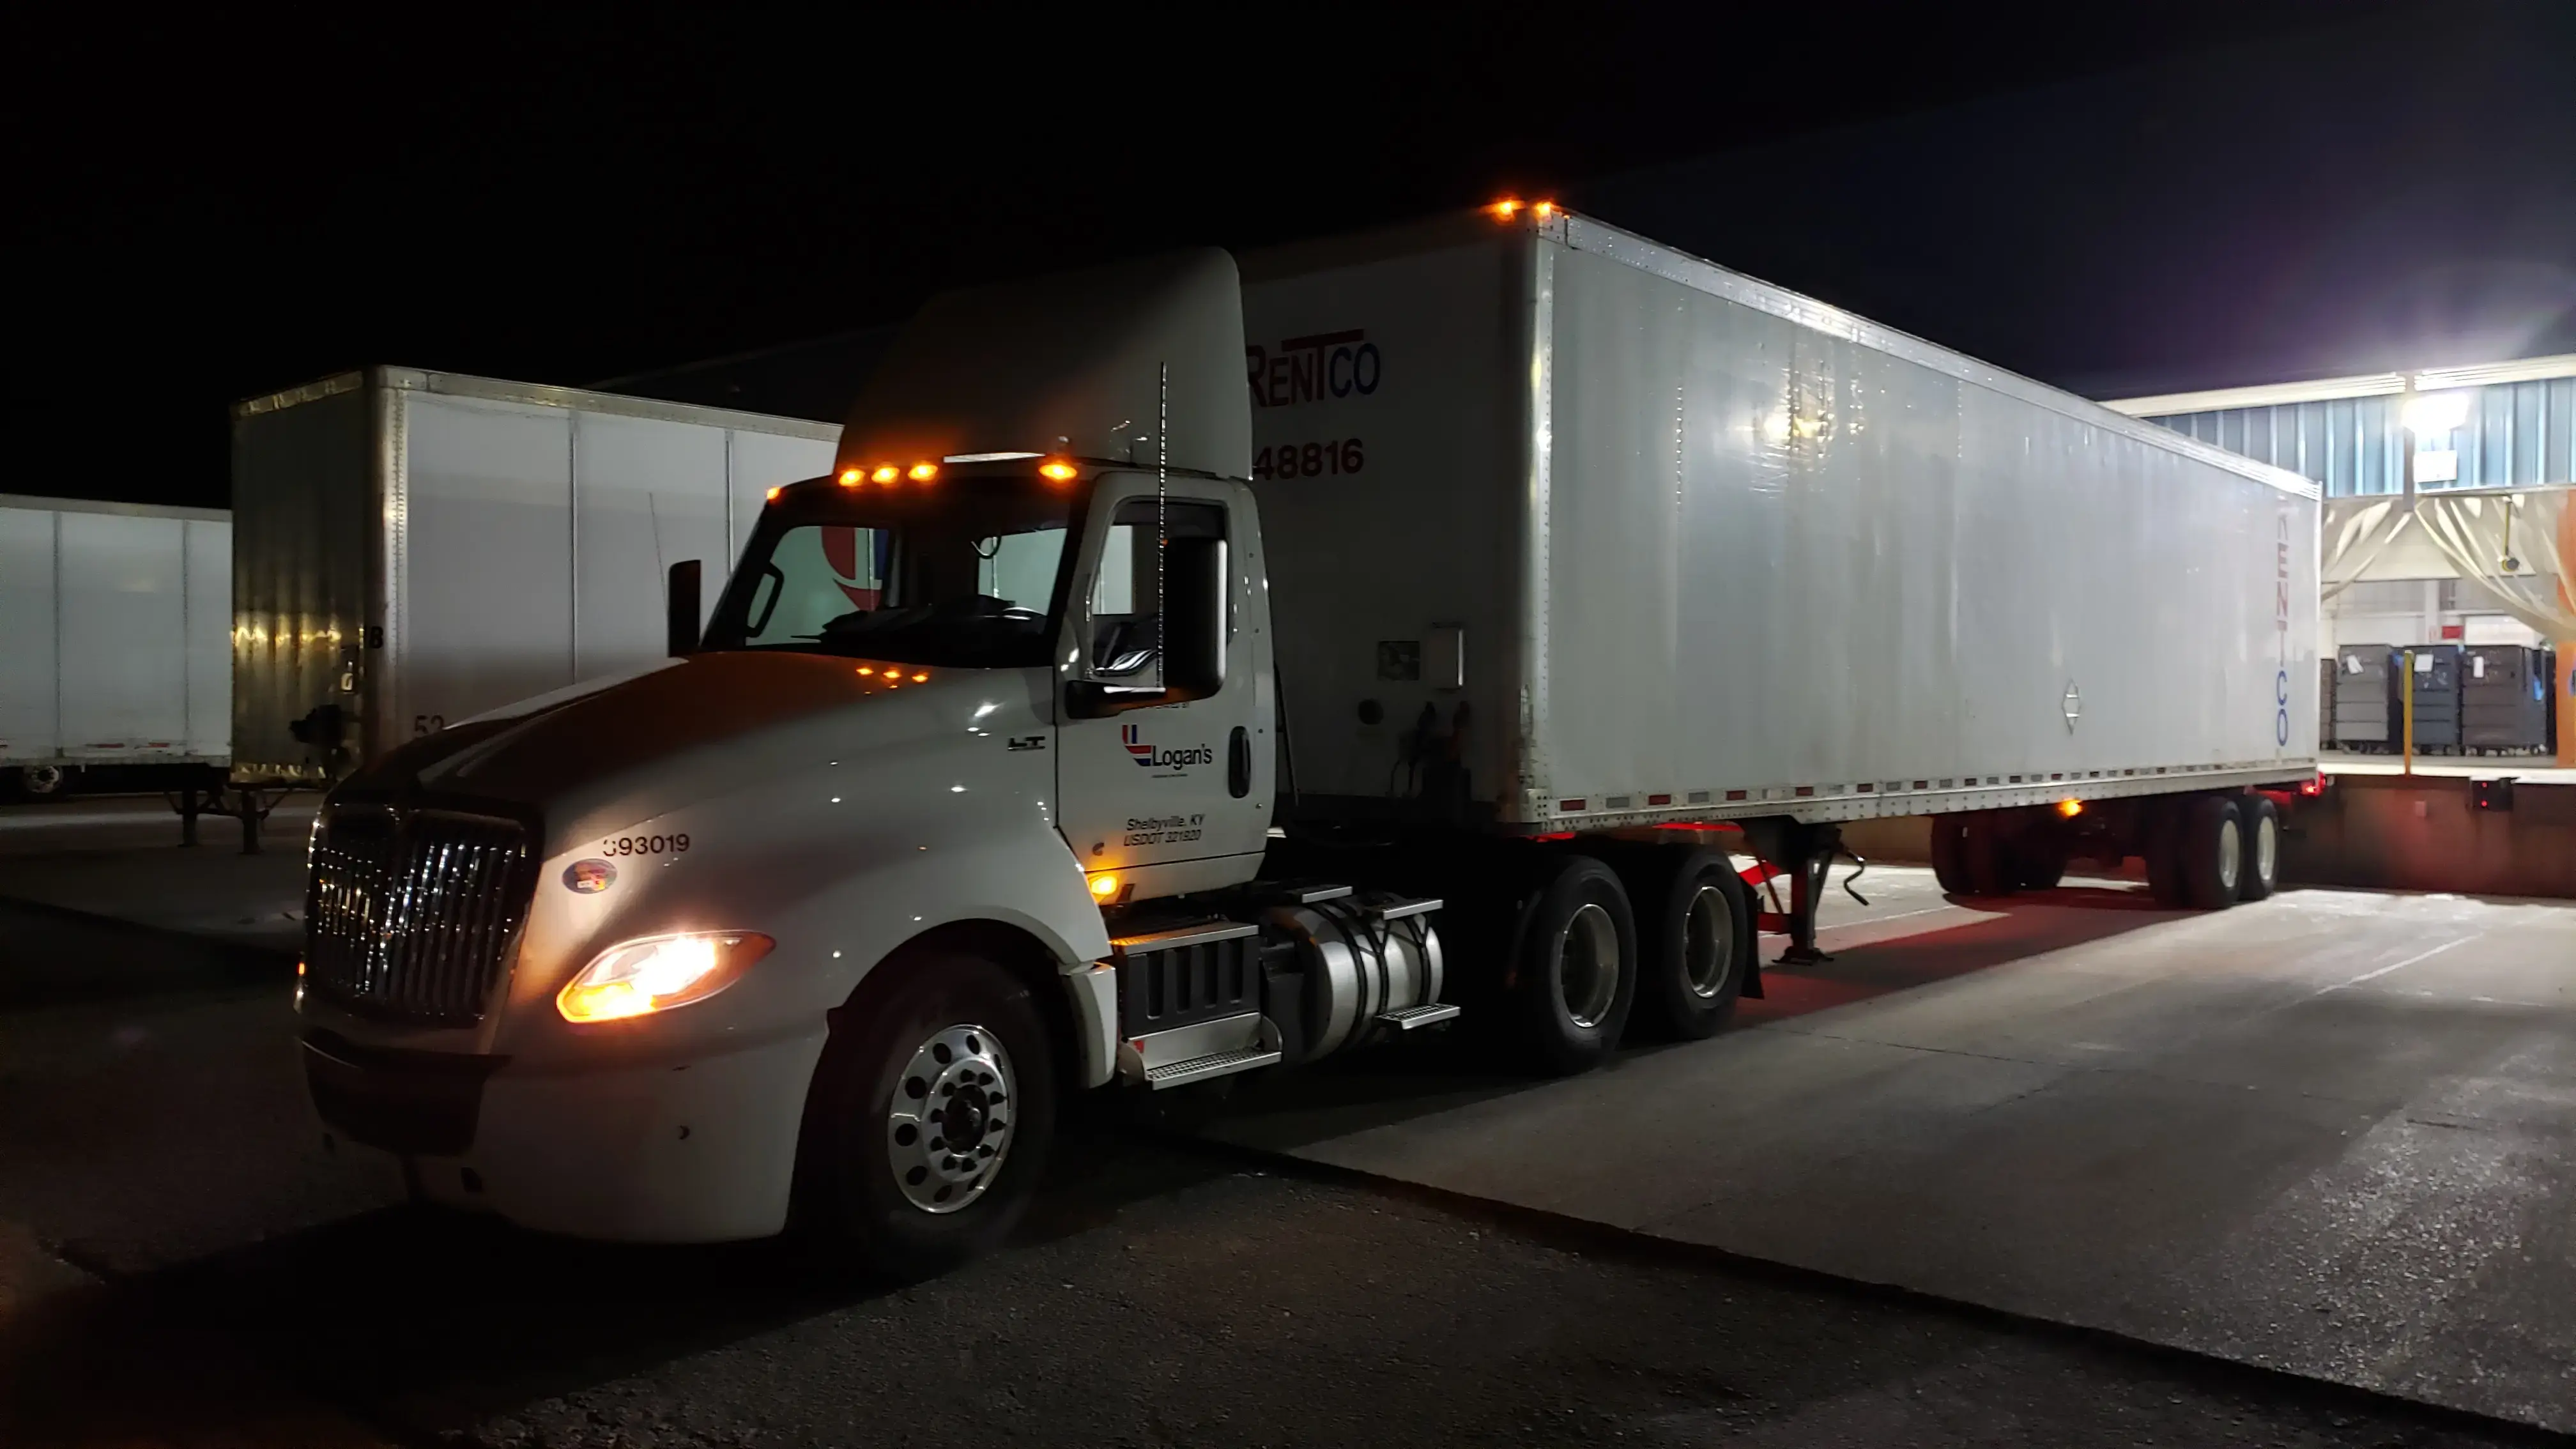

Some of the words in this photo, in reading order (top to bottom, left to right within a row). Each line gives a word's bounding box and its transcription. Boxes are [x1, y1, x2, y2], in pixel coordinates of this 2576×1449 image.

[1252, 438, 1364, 480] 48816
[1153, 743, 1212, 770] Logan's
[1190, 813, 1206, 826] KY
[1124, 831, 1164, 846] USDOT
